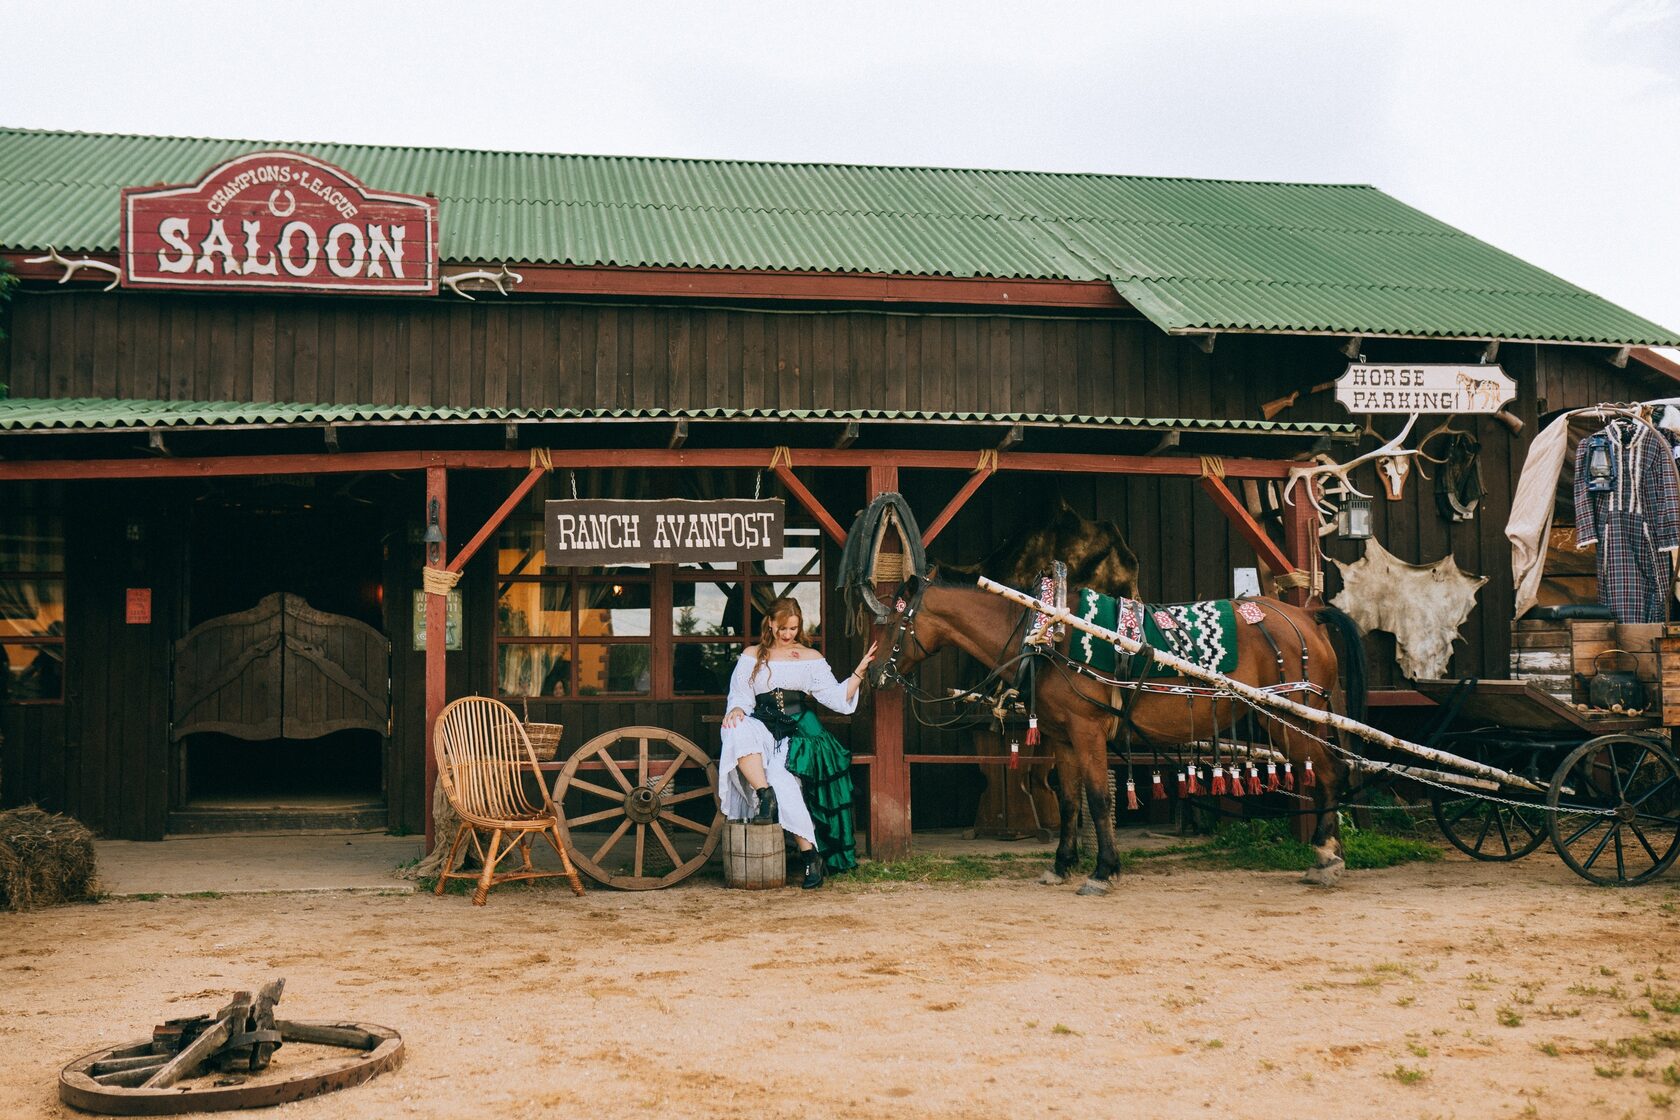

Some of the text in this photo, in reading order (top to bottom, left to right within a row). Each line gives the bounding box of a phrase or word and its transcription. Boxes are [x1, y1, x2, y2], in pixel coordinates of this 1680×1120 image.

[207, 165, 358, 219] CHAMPIONS LEAGUE
[157, 216, 406, 279] SALOON
[1353, 369, 1425, 386] HORSE
[558, 512, 775, 550] RANCH AVANPOST
